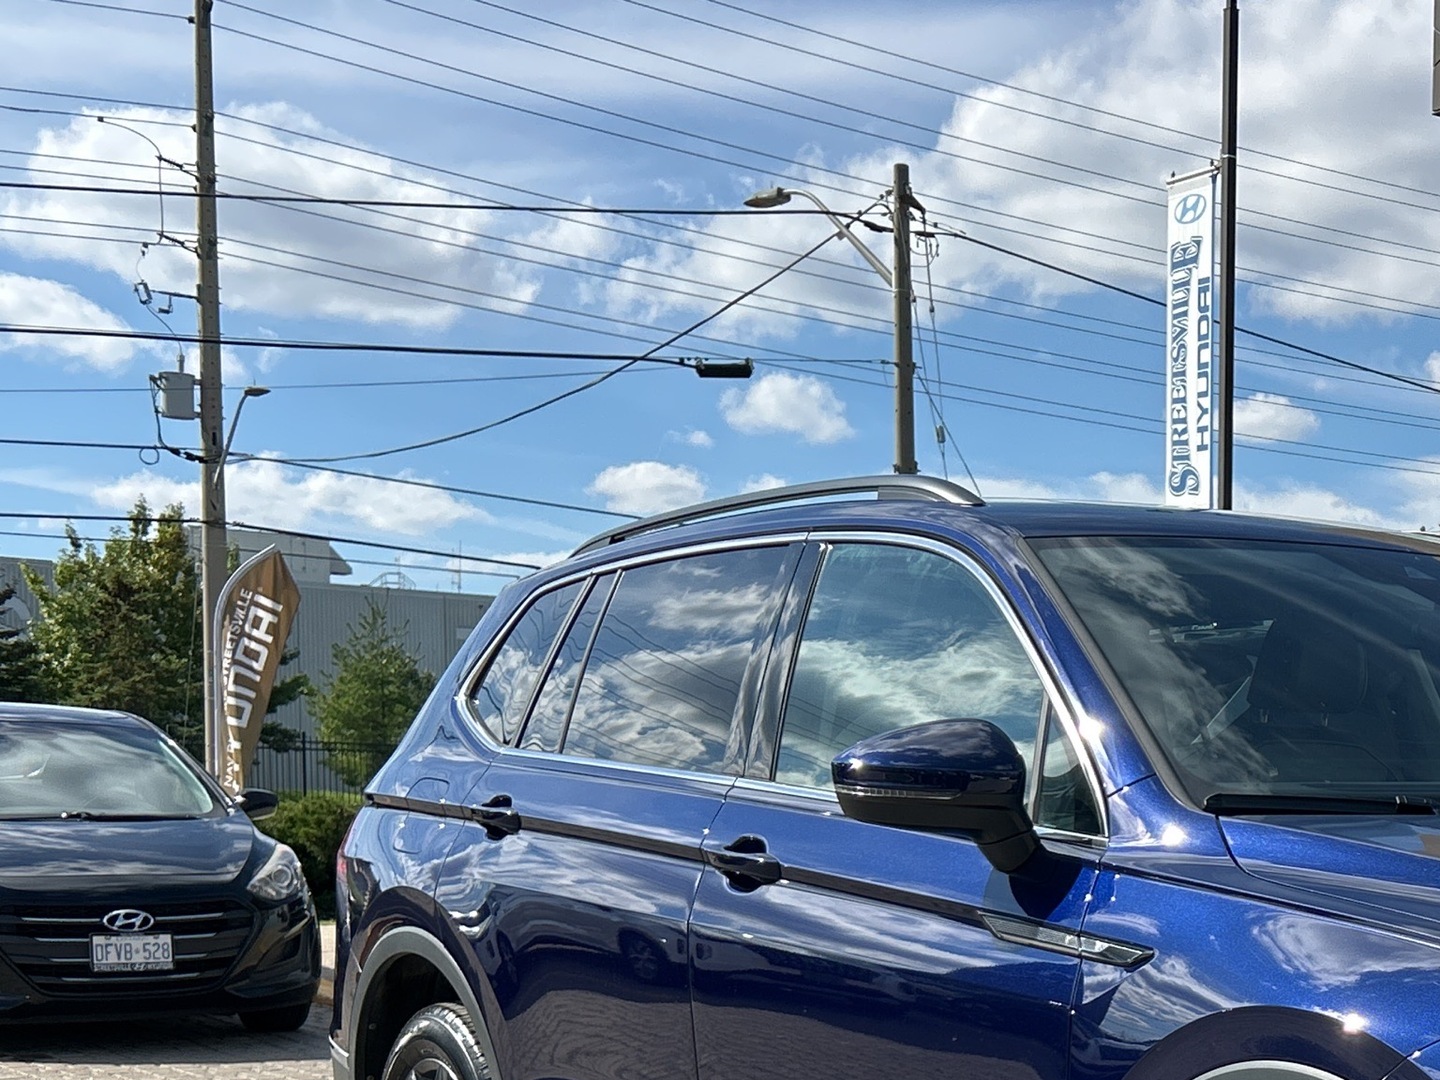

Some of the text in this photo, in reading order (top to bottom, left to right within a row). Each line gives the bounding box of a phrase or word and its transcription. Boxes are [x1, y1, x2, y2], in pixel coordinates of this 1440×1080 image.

[1169, 236, 1202, 495] STREETSVILLE
[1196, 276, 1210, 452] HYUNDAI
[94, 942, 171, 962] DFVB 528
